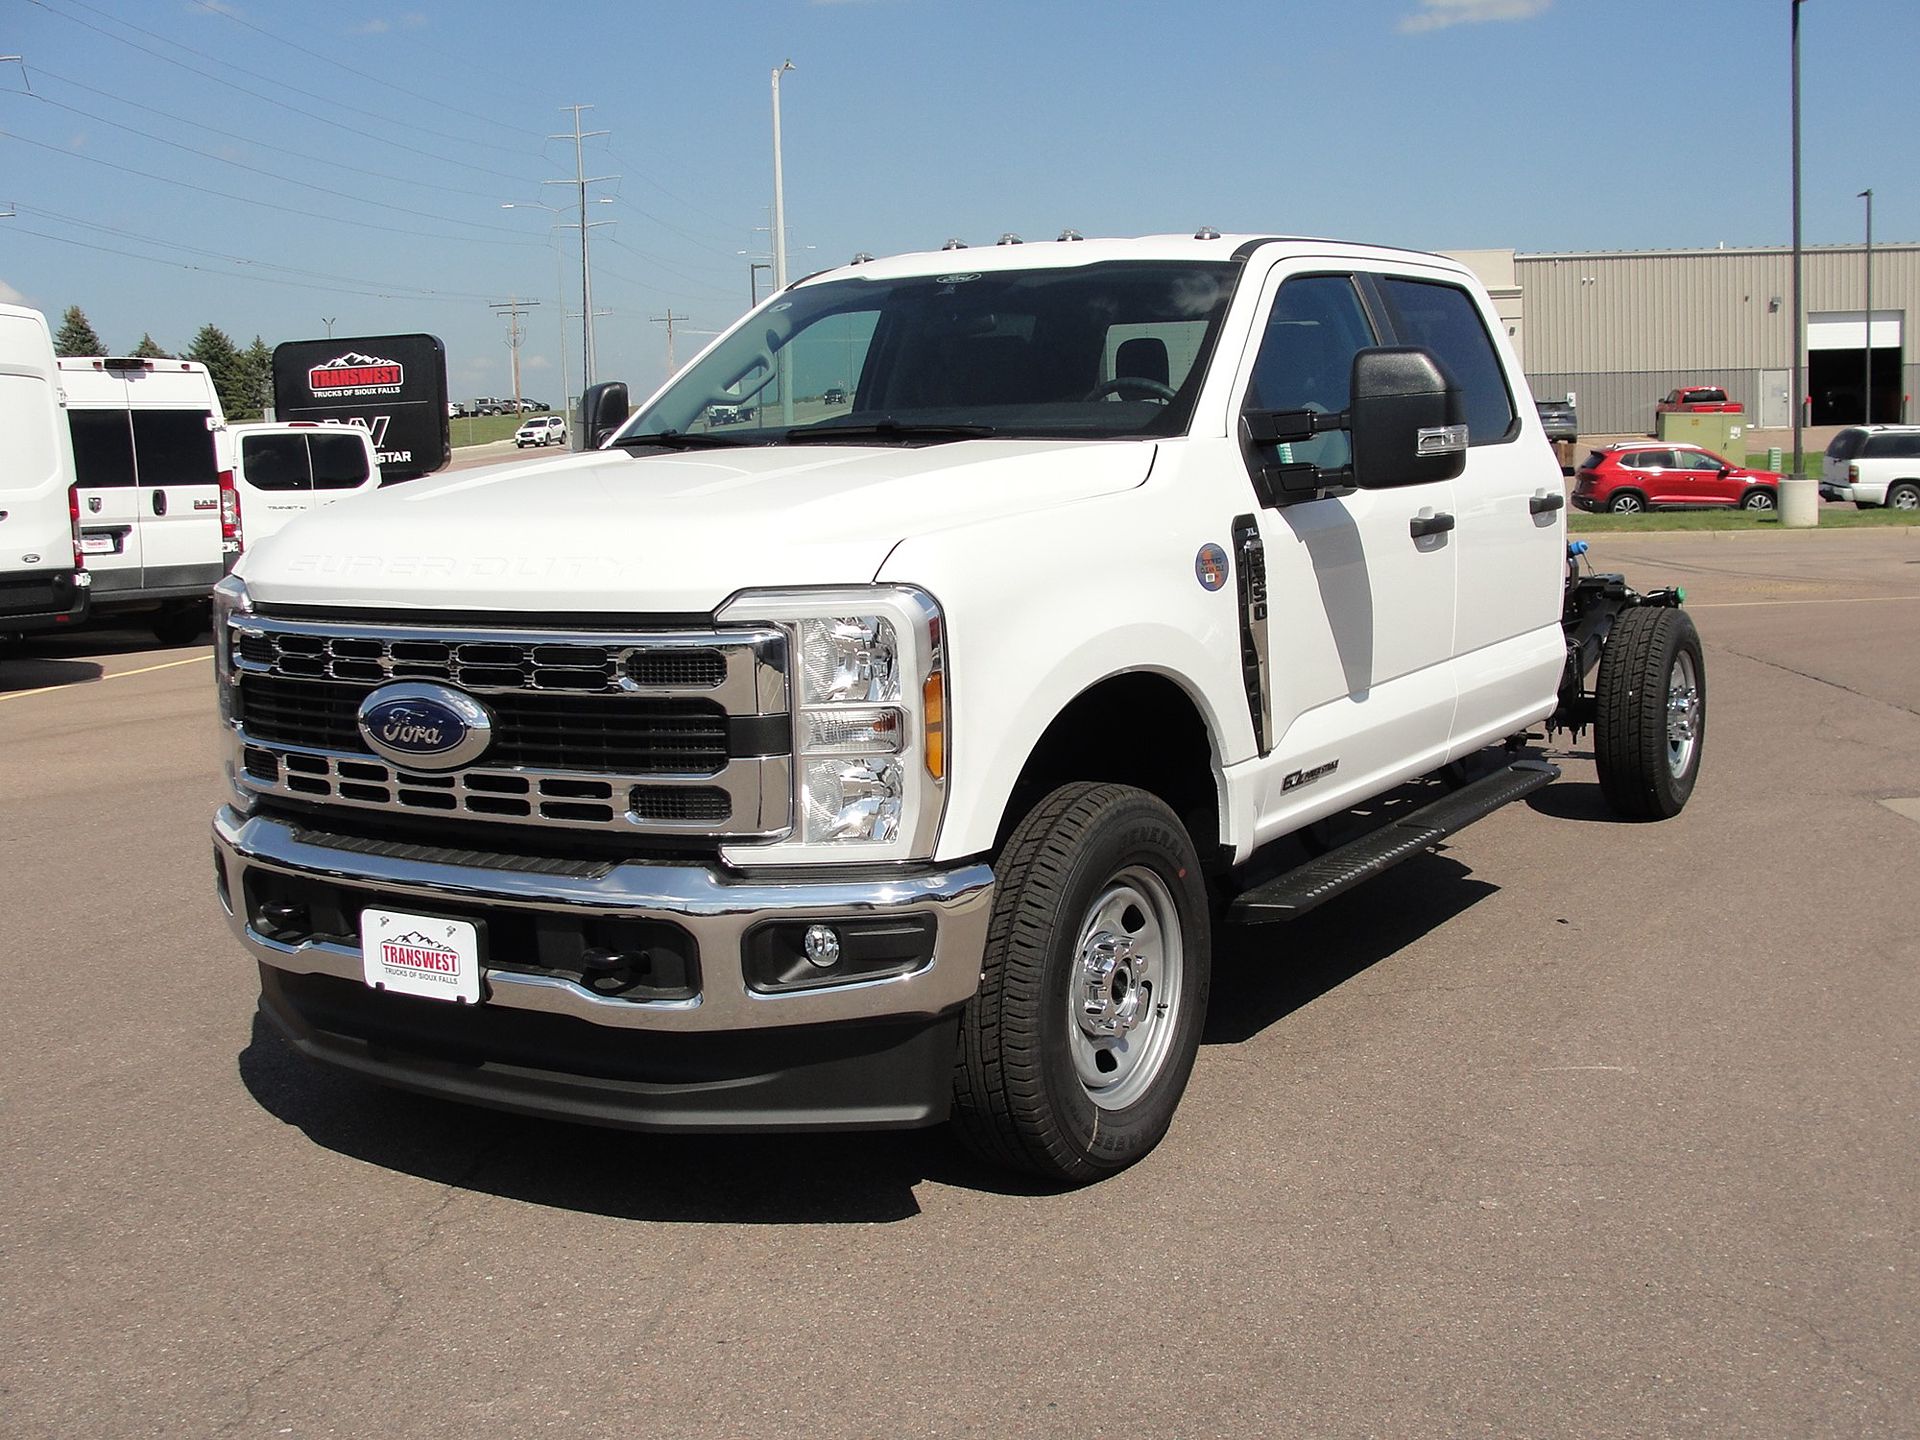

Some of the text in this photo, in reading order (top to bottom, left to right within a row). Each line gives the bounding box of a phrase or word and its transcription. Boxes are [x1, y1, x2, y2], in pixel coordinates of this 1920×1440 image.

[312, 366, 400, 388] TRANSWEST
[313, 390, 342, 398] TRUCKS
[378, 386, 401, 394] FALLS
[1246, 527, 1257, 537] XL
[287, 554, 645, 577] SUPER DUTY
[383, 707, 443, 745] Ford
[383, 945, 457, 972] TRANSWEST
[385, 967, 408, 977] TRUCKS
[419, 973, 437, 982] SIOUX
[438, 976, 458, 985] FALLS
